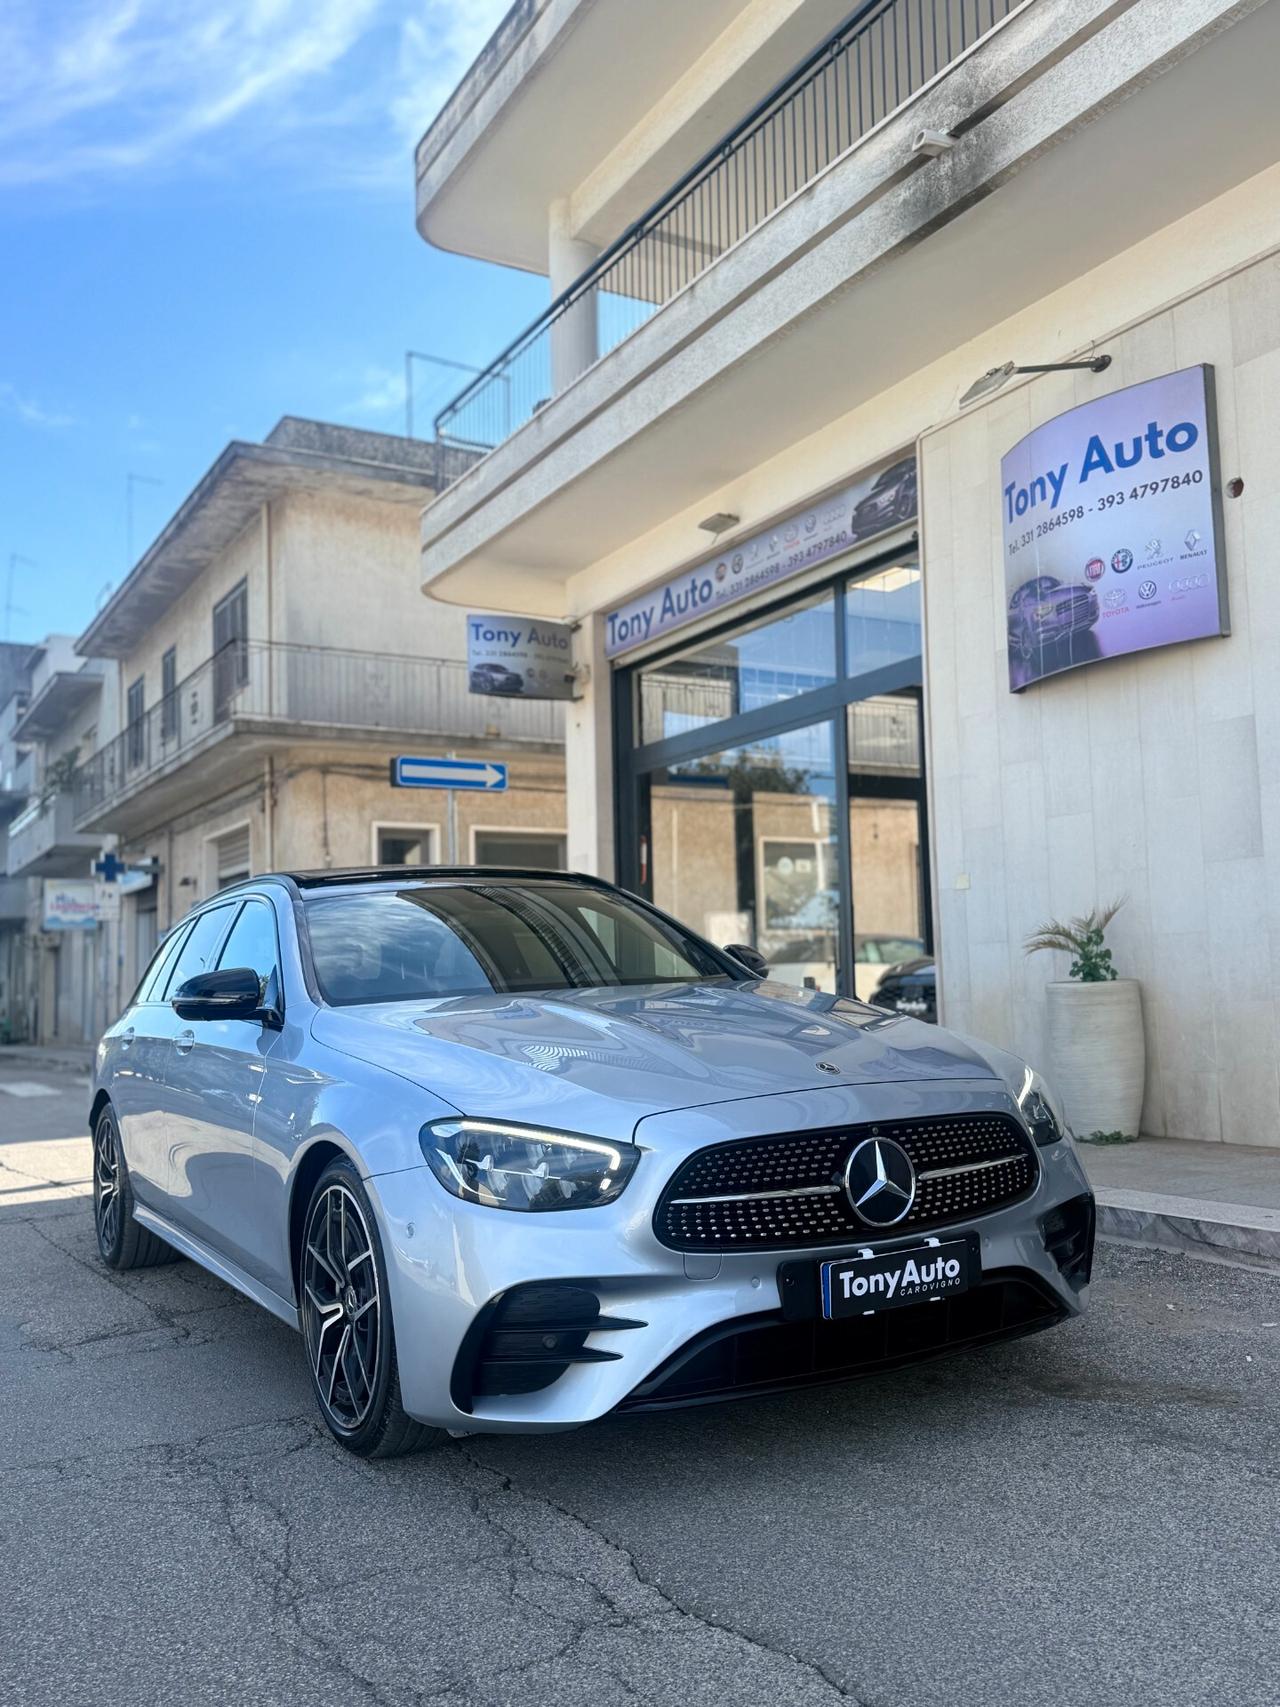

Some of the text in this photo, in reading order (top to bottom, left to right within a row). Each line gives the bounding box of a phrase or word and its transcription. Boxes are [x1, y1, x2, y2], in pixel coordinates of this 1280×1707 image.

[1005, 421, 1199, 524] Tony Auto
[1021, 529, 1034, 547] 331
[1036, 505, 1084, 538] 2864598
[1097, 490, 1126, 512] 393
[1129, 469, 1203, 502] 4797840
[787, 550, 805, 568] 393
[806, 530, 848, 556] 4797840
[1179, 549, 1208, 560] RENAULT
[607, 577, 713, 646] Tony Auto
[1102, 606, 1130, 618] TOYOTA
[471, 623, 569, 650] Tony Auto
[839, 1257, 960, 1299] TonyAuto
[900, 1277, 961, 1297] CAROVIGNO
